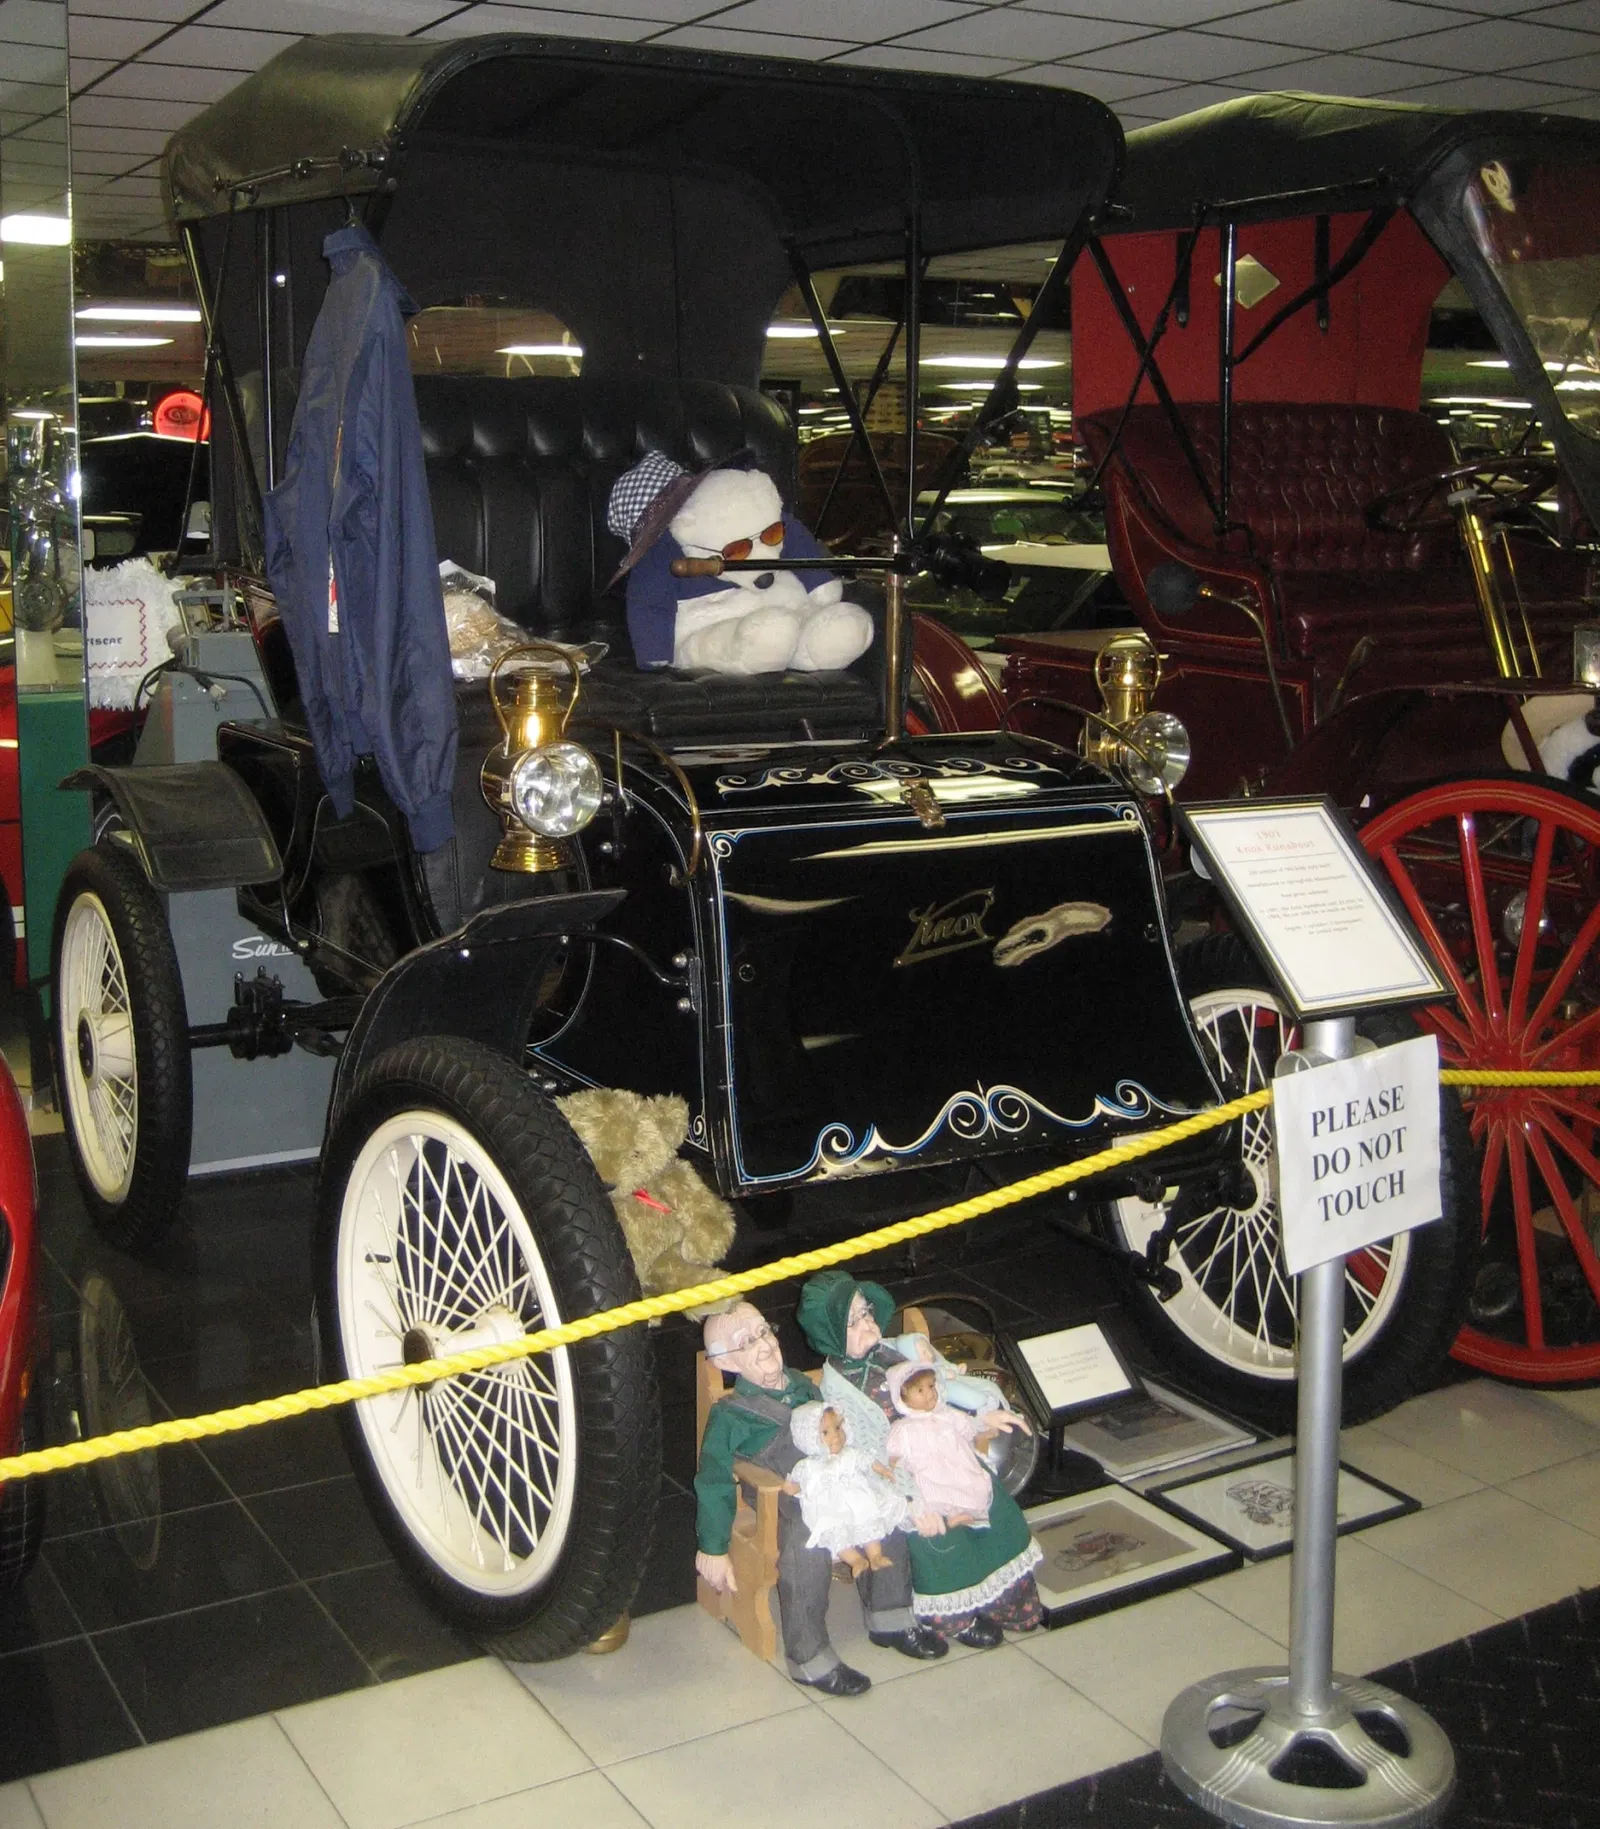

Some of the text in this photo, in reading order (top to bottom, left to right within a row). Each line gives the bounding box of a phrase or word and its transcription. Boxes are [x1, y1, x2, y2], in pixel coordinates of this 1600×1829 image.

[1235, 840, 1315, 854] Knox Runabout
[1255, 829, 1281, 840] 1901
[231, 935, 287, 960] Sun
[1311, 1085, 1405, 1138] PLEASE
[1312, 1126, 1407, 1181] DO NOT
[1317, 1169, 1405, 1222] TOUCH
